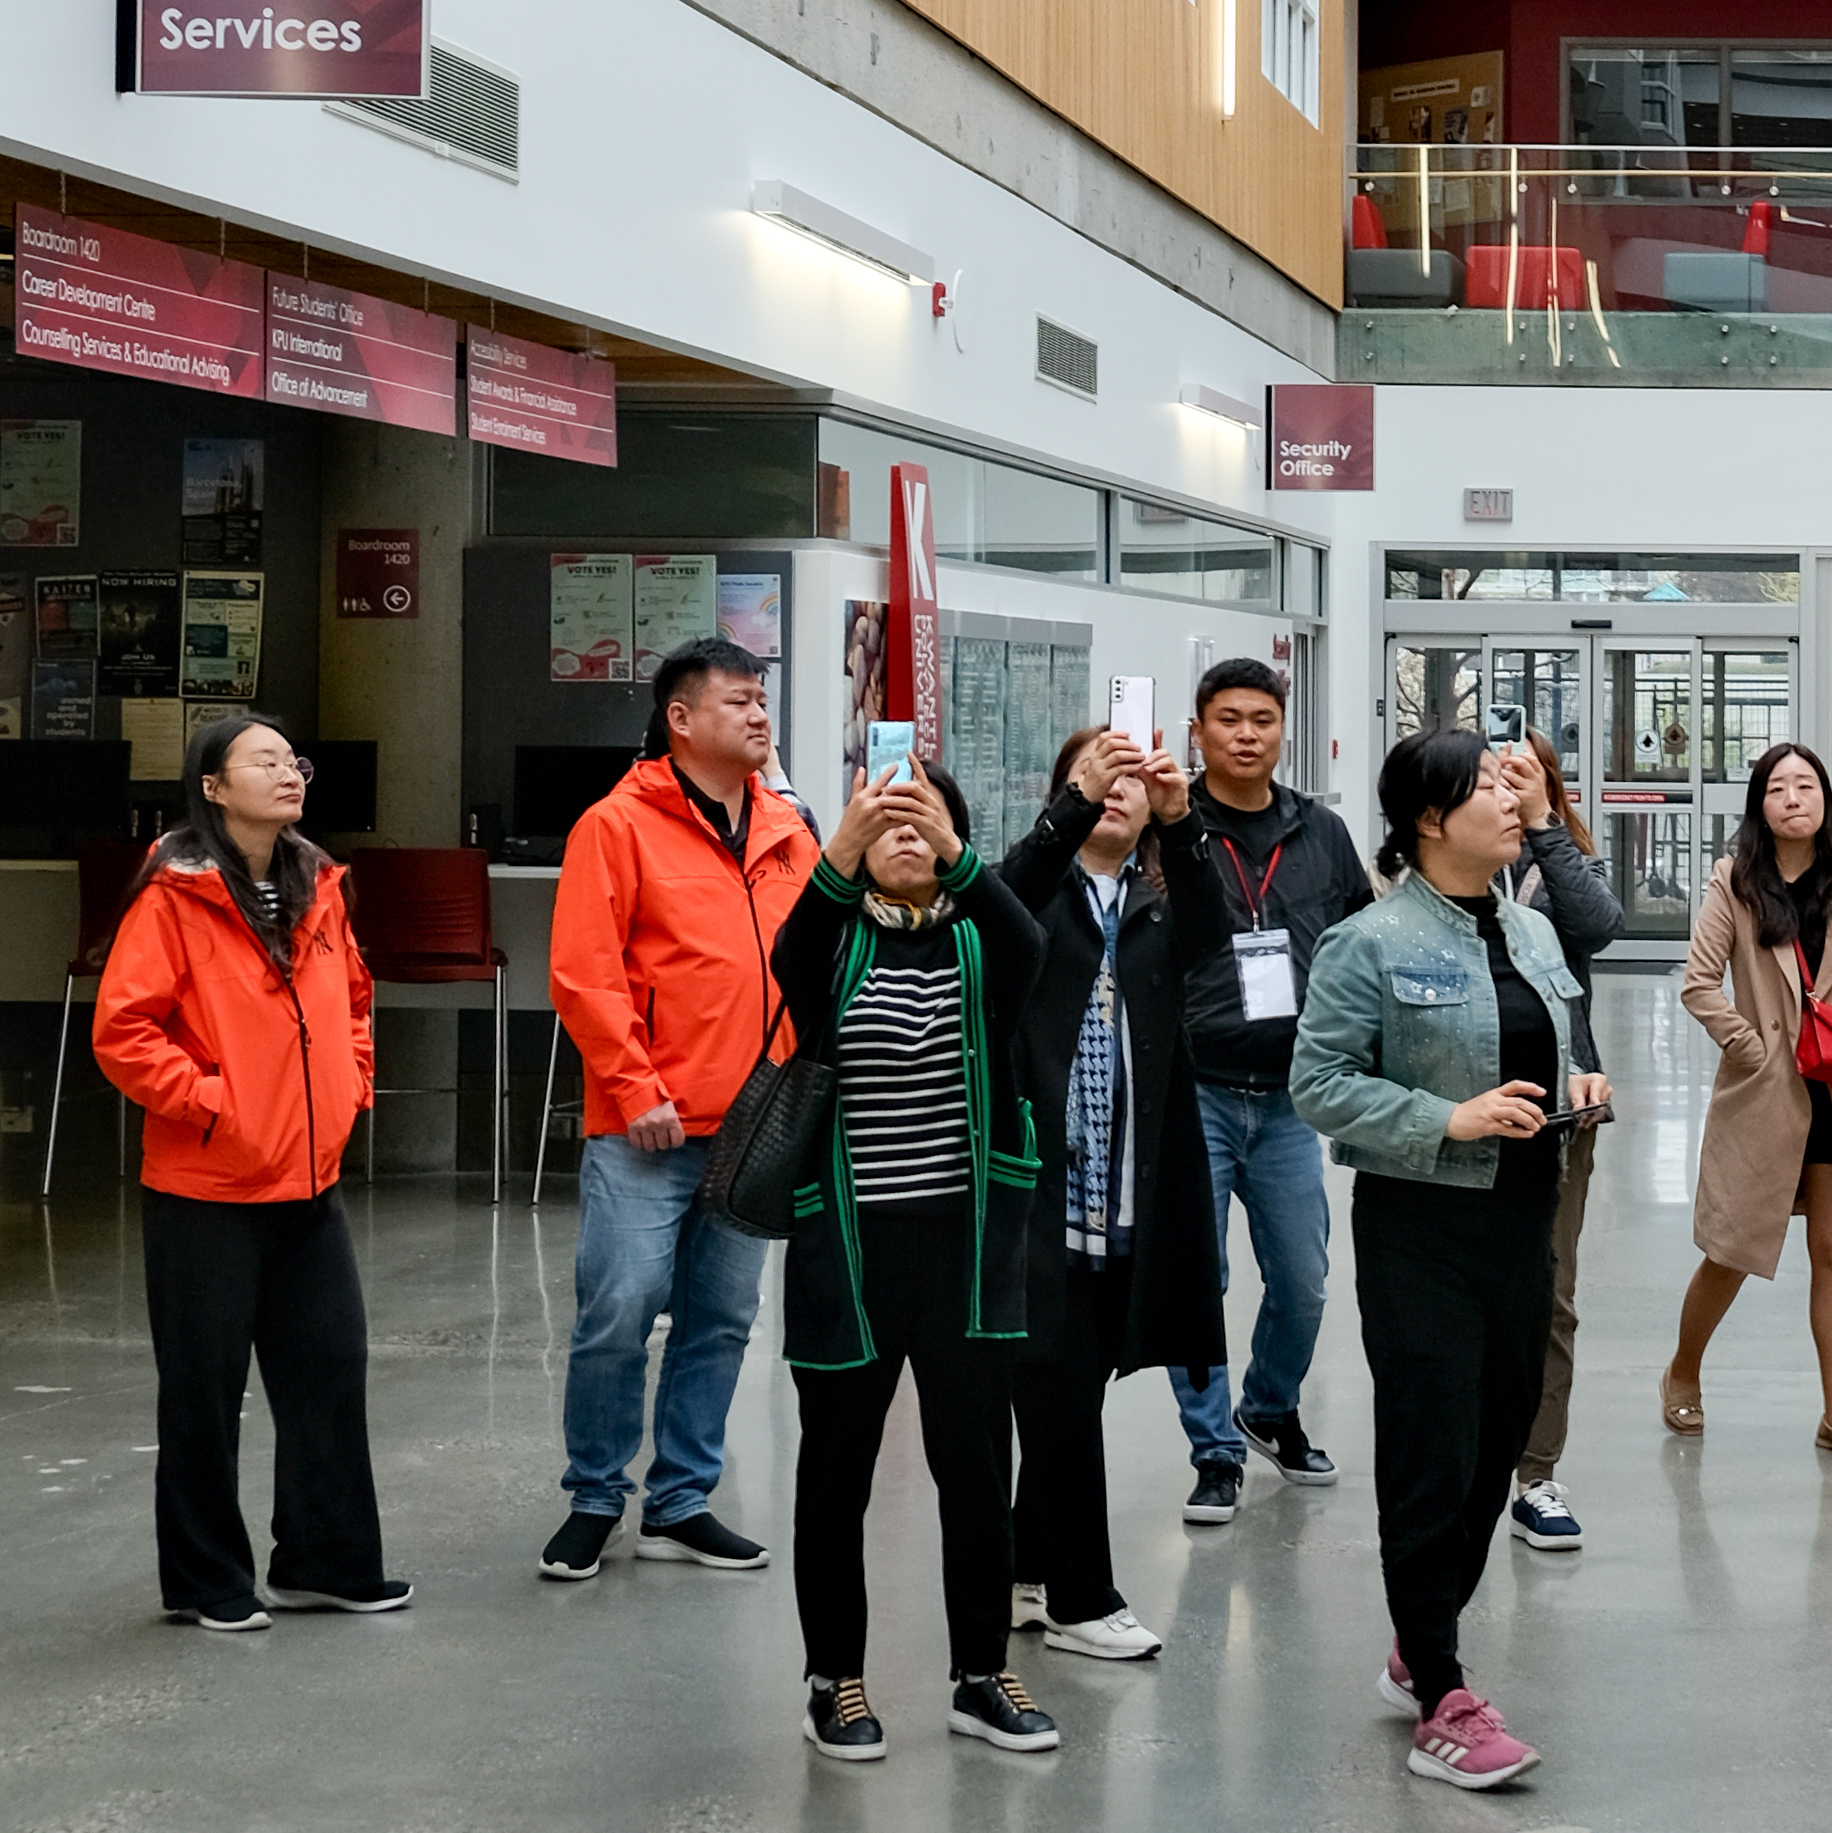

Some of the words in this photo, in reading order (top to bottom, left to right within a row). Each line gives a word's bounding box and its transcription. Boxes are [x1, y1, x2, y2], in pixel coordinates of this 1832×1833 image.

[160, 7, 363, 53] Services
[23, 222, 78, 256] Boardroom
[79, 236, 100, 262] 1420
[22, 270, 57, 298] Career
[59, 278, 123, 313] Development
[124, 293, 156, 321] Centre
[272, 286, 299, 311] Future
[339, 303, 364, 327] Office
[22, 320, 81, 358] Counselling
[82, 331, 122, 362] Services
[124, 341, 132, 362] &
[134, 342, 190, 374] Educational
[191, 357, 230, 386] Advising
[272, 329, 289, 351] KPU
[290, 334, 342, 362] International
[504, 347, 527, 369] Services
[272, 371, 298, 396] Office
[299, 377, 309, 395] of
[310, 381, 368, 409] Advancement
[471, 374, 492, 396] Student
[520, 387, 546, 409] Financial
[547, 394, 577, 417] Assistance
[16, 431, 42, 440] VOTE
[471, 412, 493, 433] Student
[522, 423, 546, 445] Services
[1280, 440, 1352, 460] Security
[1280, 459, 1334, 477] Office
[1470, 490, 1510, 516] EXIT
[348, 539, 411, 551] Boardroom
[384, 553, 411, 565] 1420
[567, 566, 593, 574] VOTE
[595, 566, 617, 574] YES!
[651, 567, 677, 575] VOTE
[679, 567, 700, 575] YES!
[101, 578, 129, 587] NOW
[133, 578, 177, 587] HIRING
